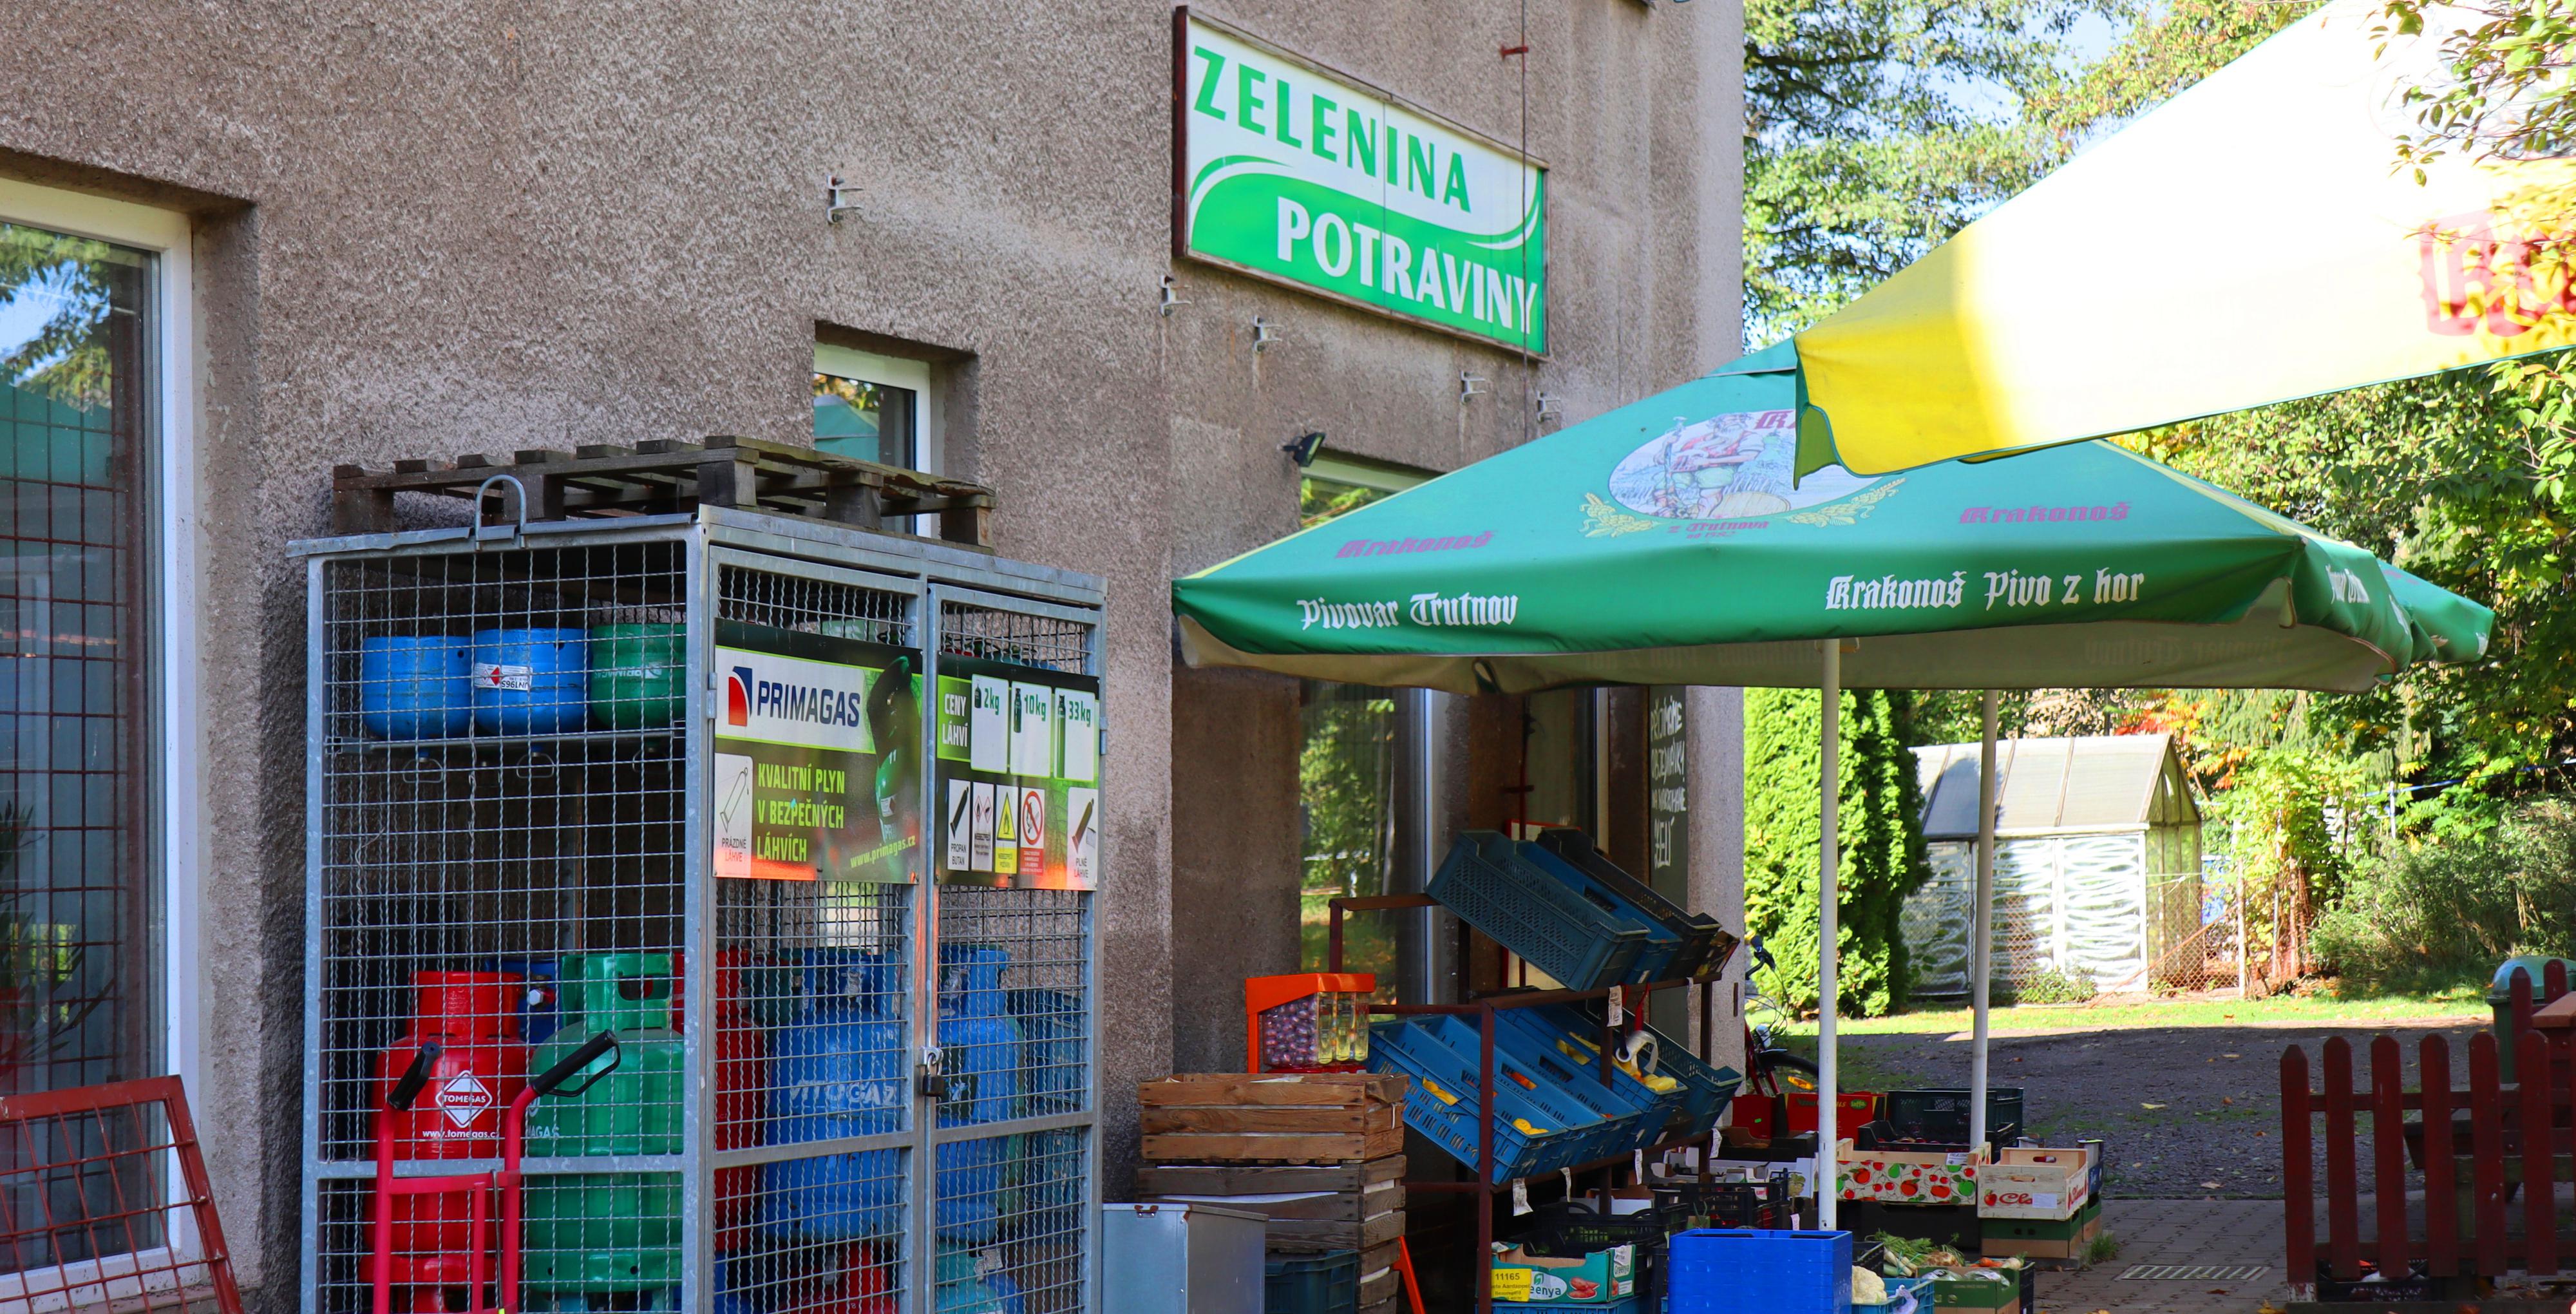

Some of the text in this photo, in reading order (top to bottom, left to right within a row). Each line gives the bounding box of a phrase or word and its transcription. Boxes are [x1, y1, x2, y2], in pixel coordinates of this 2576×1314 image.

[1194, 45, 1472, 213] ZELENINA
[1277, 195, 1537, 334] POTRAVINY
[1686, 521, 1769, 532] Trutnova
[1824, 567, 2145, 611] Krakonoš Pivo z hor
[1296, 591, 1519, 632] Pivovar Trutnov
[757, 680, 860, 727] PRIMAGAS
[944, 693, 967, 717] CENY
[942, 719, 969, 748] LÁHVÍ
[758, 763, 846, 794] KVALITNÍ PLYN
[757, 796, 844, 829] V BEZPEČNÝCH
[721, 837, 746, 850] PRÁZDNÉ
[757, 830, 808, 862] LÁHVÍCH
[850, 834, 916, 868] www.primagas.cz
[951, 843, 967, 853] PROPAN
[724, 852, 743, 862] LÁHVE
[952, 855, 965, 866] BUTAN
[1075, 857, 1087, 867] PLNÉ
[1074, 869, 1089, 879] LÁHVE
[443, 1095, 486, 1103] TOMEGAS
[422, 1128, 500, 1139] www.tomegas.c
[1495, 1273, 1520, 1281] 11165
